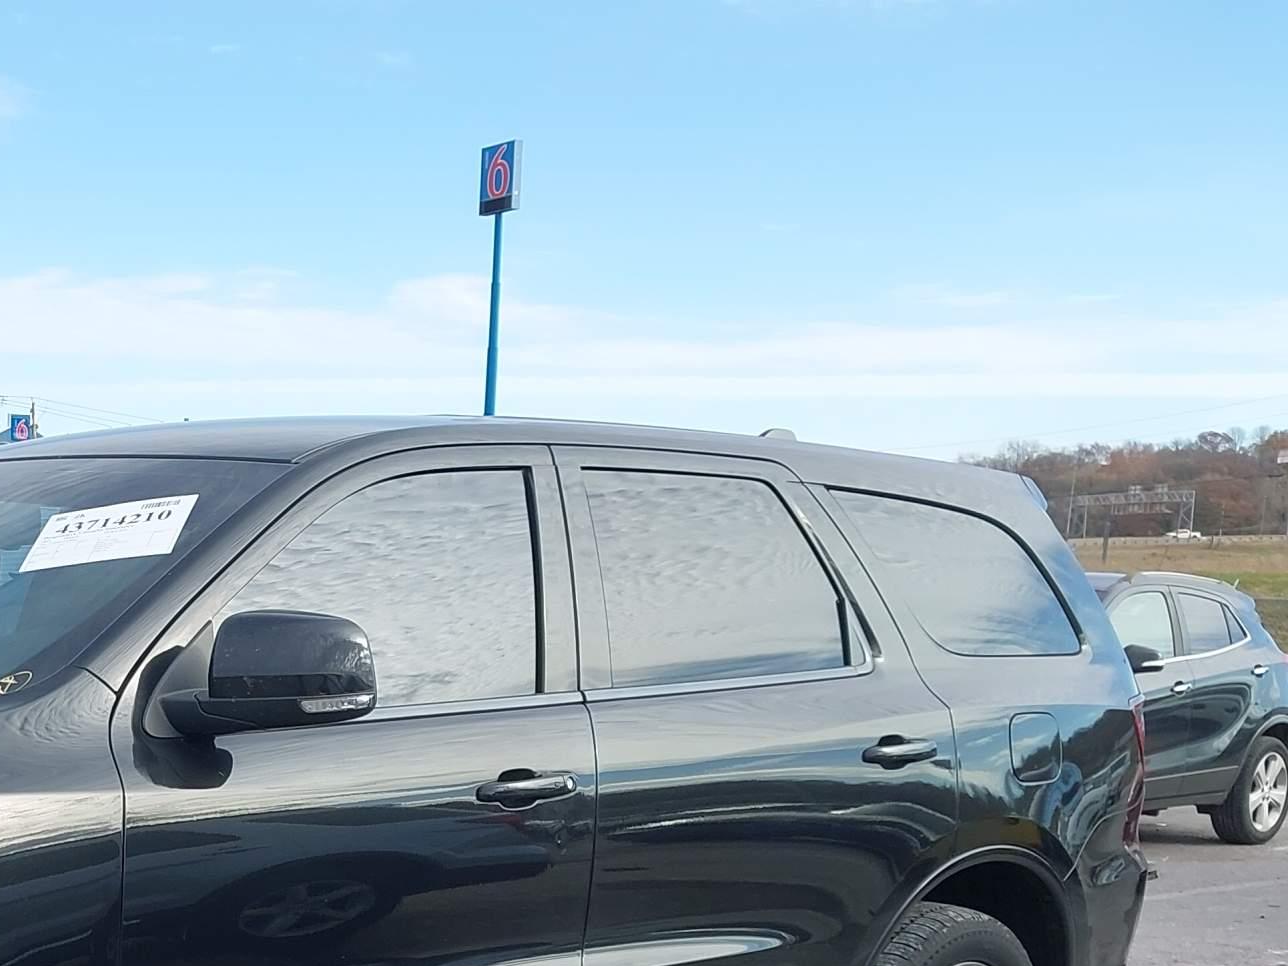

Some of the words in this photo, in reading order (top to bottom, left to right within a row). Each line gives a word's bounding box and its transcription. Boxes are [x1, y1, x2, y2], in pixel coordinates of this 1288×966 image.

[487, 144, 510, 199] 6
[16, 419, 28, 440] 6
[55, 509, 172, 534] 43714210
